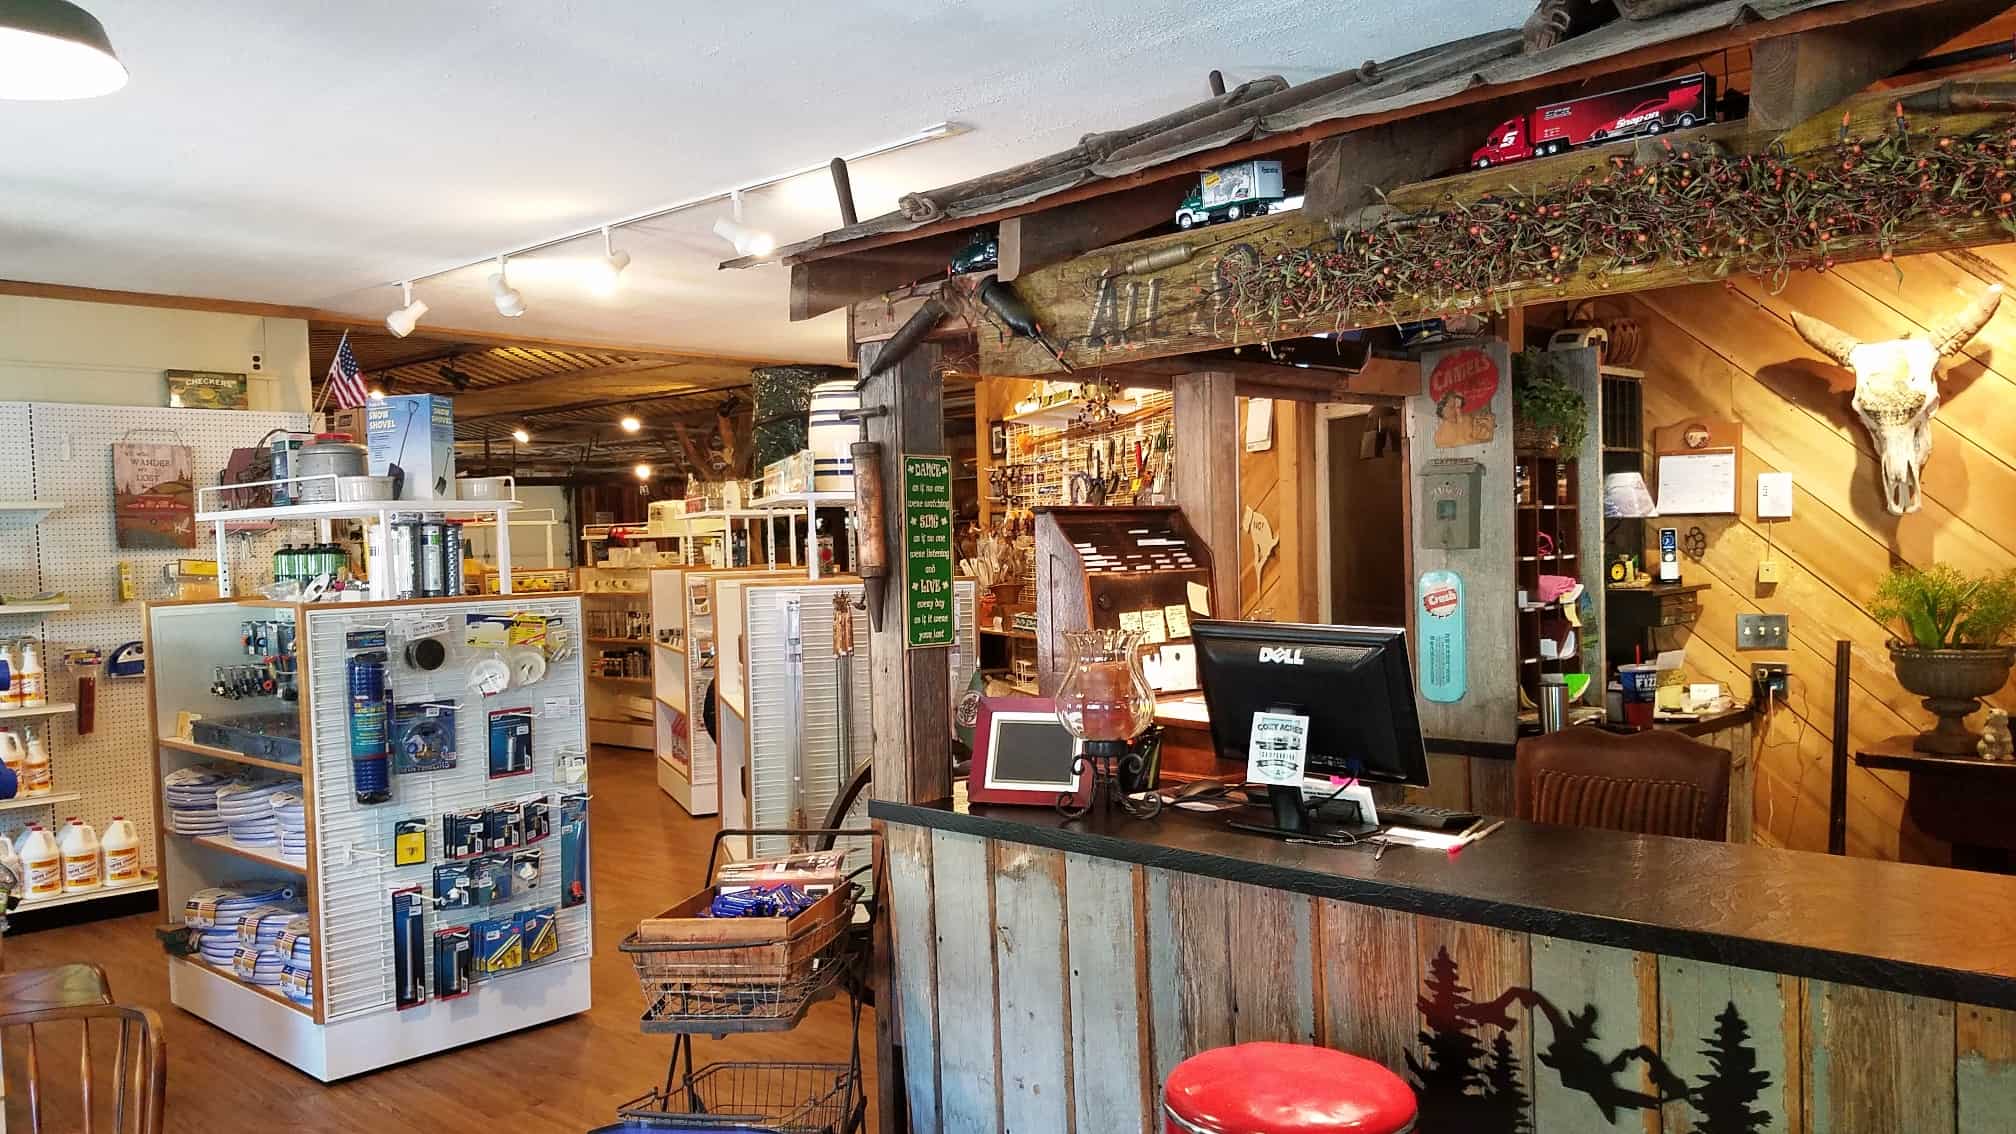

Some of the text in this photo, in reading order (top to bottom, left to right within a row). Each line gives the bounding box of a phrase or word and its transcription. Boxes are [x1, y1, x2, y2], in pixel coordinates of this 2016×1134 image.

[914, 463, 942, 478] DANCE
[920, 514, 938, 528] SING
[920, 579, 941, 593] LIVE
[1259, 647, 1304, 665] DELL
